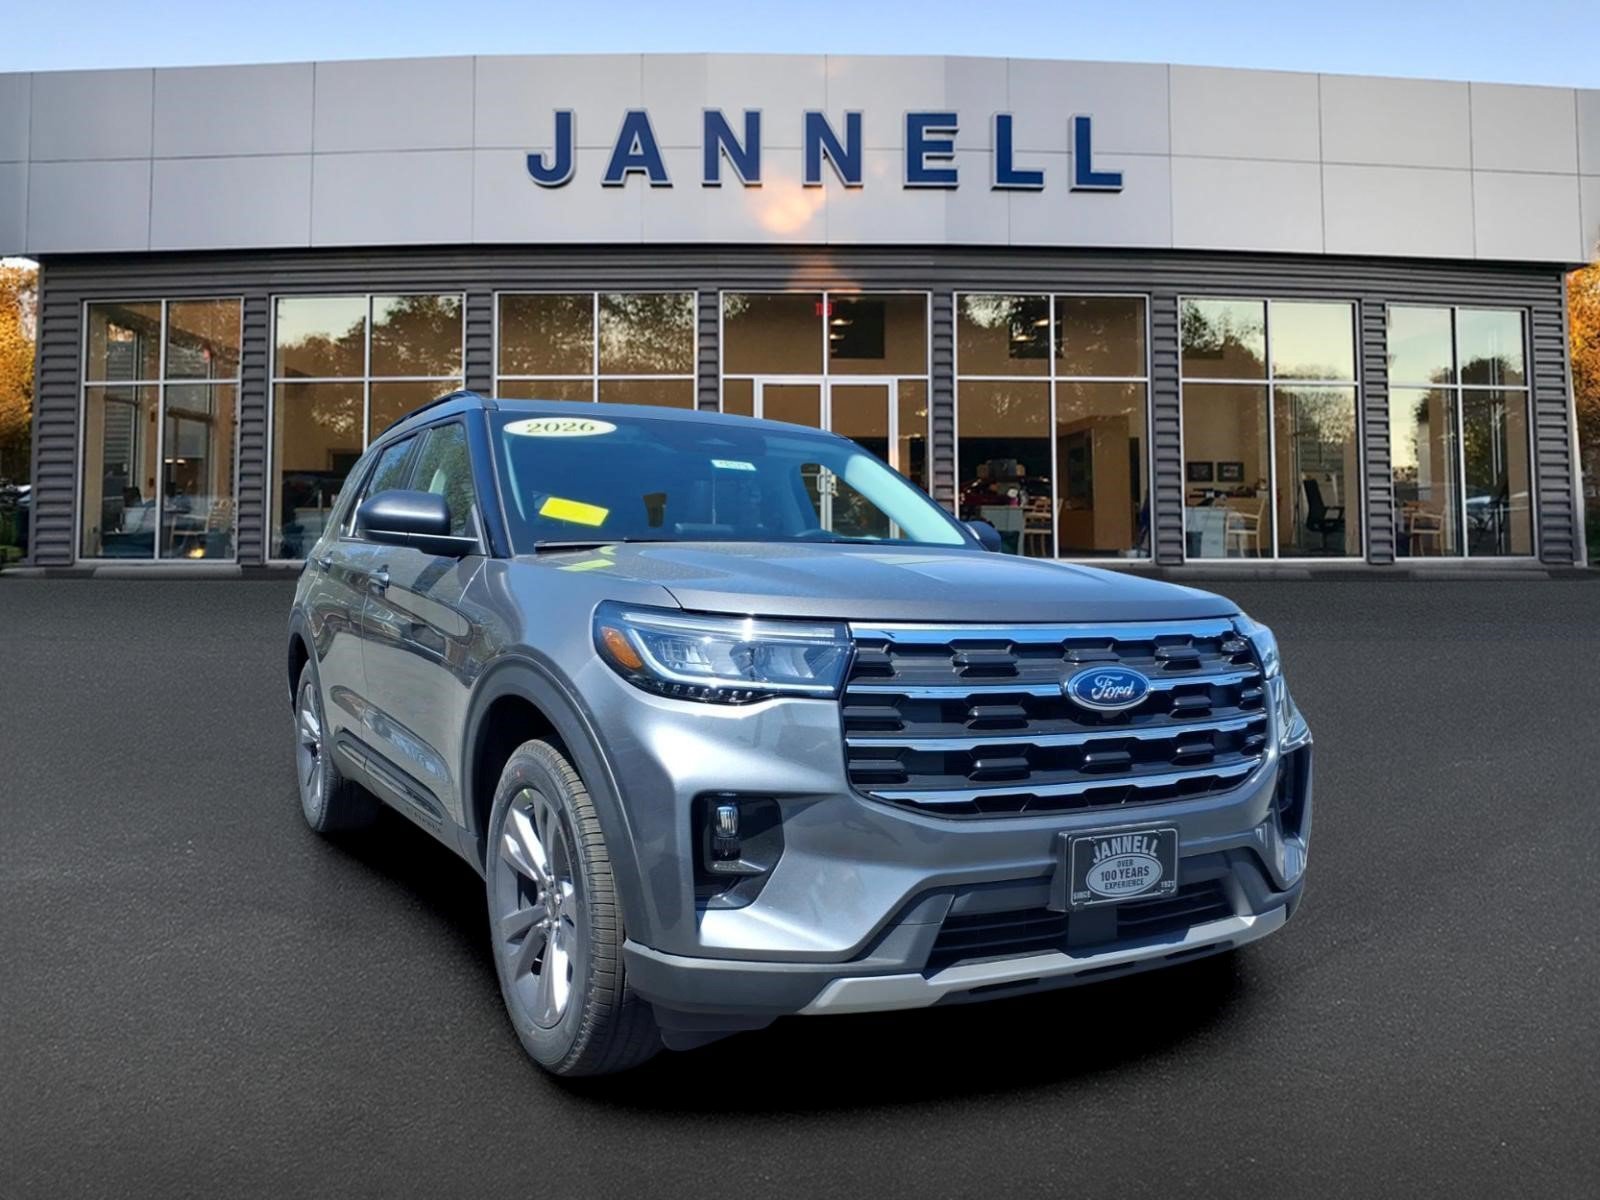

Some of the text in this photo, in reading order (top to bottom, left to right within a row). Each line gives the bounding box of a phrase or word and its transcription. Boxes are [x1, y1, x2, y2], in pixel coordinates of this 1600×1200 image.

[525, 107, 1124, 192] JANNELL
[527, 422, 594, 433] 2026
[1091, 675, 1135, 700] Ford
[1093, 835, 1158, 863] JANNELL
[1117, 859, 1134, 868] OVER
[1101, 866, 1150, 882] 100 YEARS
[1104, 879, 1145, 890] EXPERIENCE
